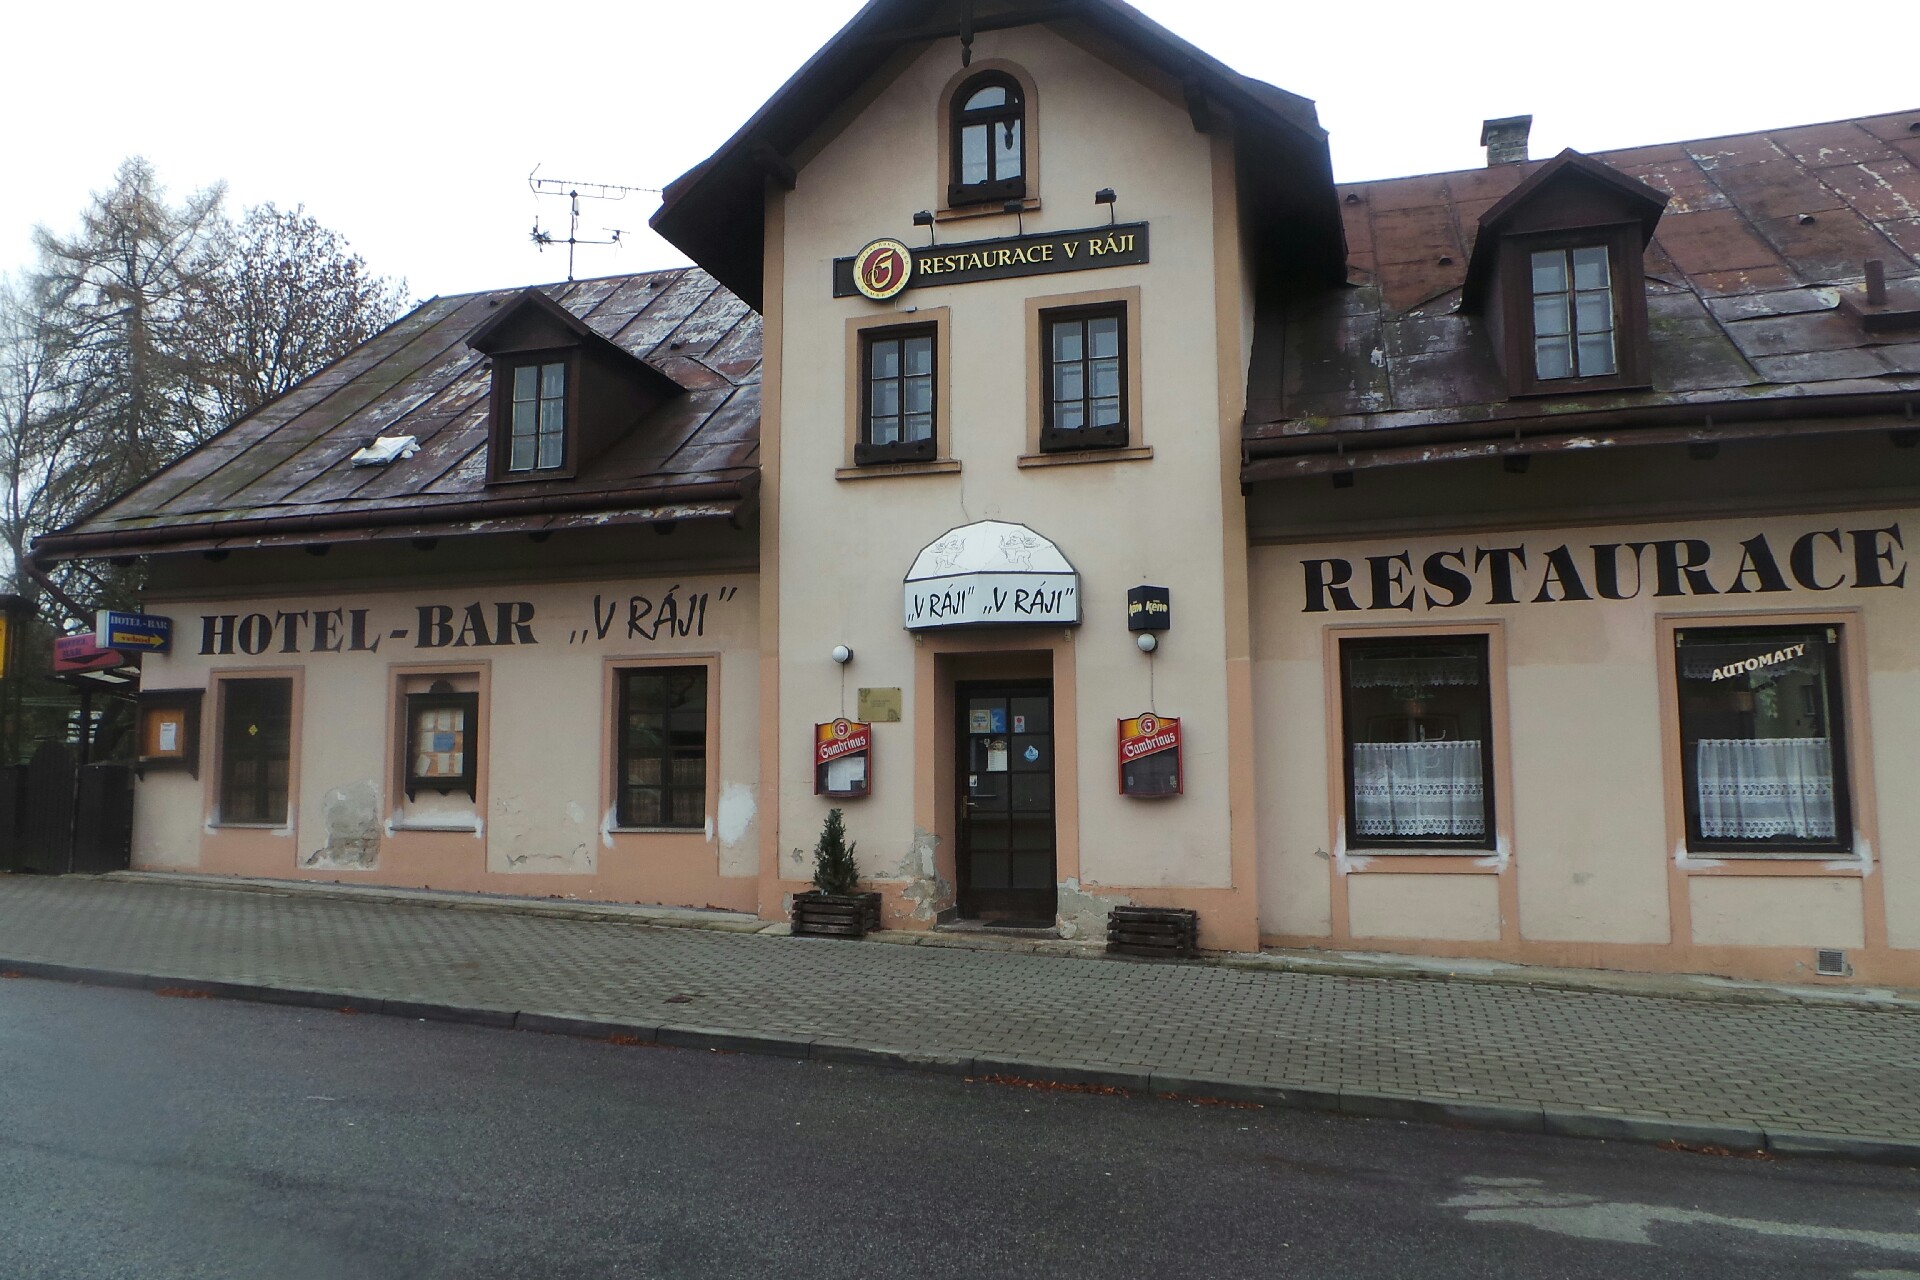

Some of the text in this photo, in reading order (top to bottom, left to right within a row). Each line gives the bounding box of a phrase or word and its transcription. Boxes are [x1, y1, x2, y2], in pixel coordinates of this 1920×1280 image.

[919, 244, 1053, 275] RESTAURACE
[1063, 241, 1079, 259] V
[1089, 232, 1134, 256] RÁJI
[1299, 522, 1908, 613] RESTAURACE
[1711, 643, 1805, 682] AUTOMATY
[820, 735, 866, 759] Gambrinus
[1123, 732, 1176, 757] Gambrinus
